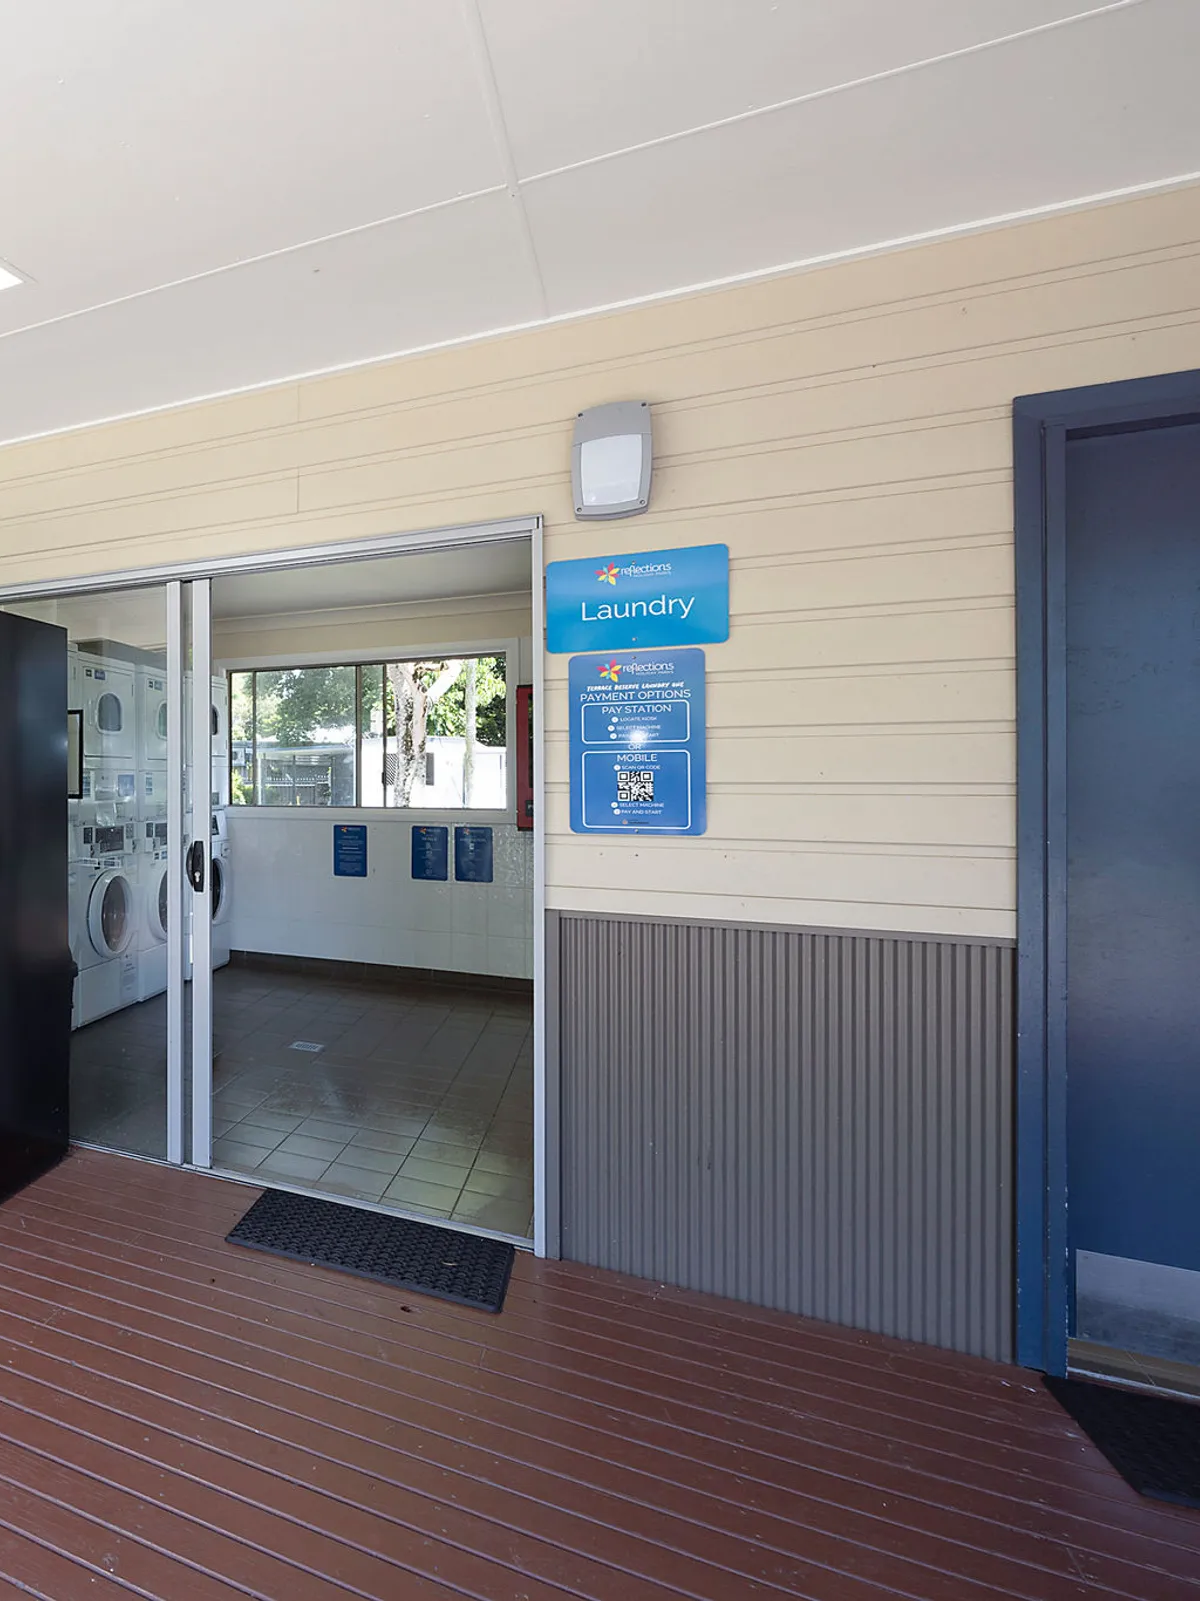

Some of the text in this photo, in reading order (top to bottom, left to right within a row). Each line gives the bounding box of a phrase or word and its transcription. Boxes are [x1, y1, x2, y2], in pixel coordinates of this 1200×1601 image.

[620, 562, 672, 577] reflections
[581, 594, 695, 622] Laundry
[622, 662, 674, 675] reflections
[614, 683, 640, 691] RESERVE
[580, 689, 692, 702] PAYMENT OPTIONS
[601, 704, 672, 715] PAY STATION
[616, 753, 658, 762] MOBILE
